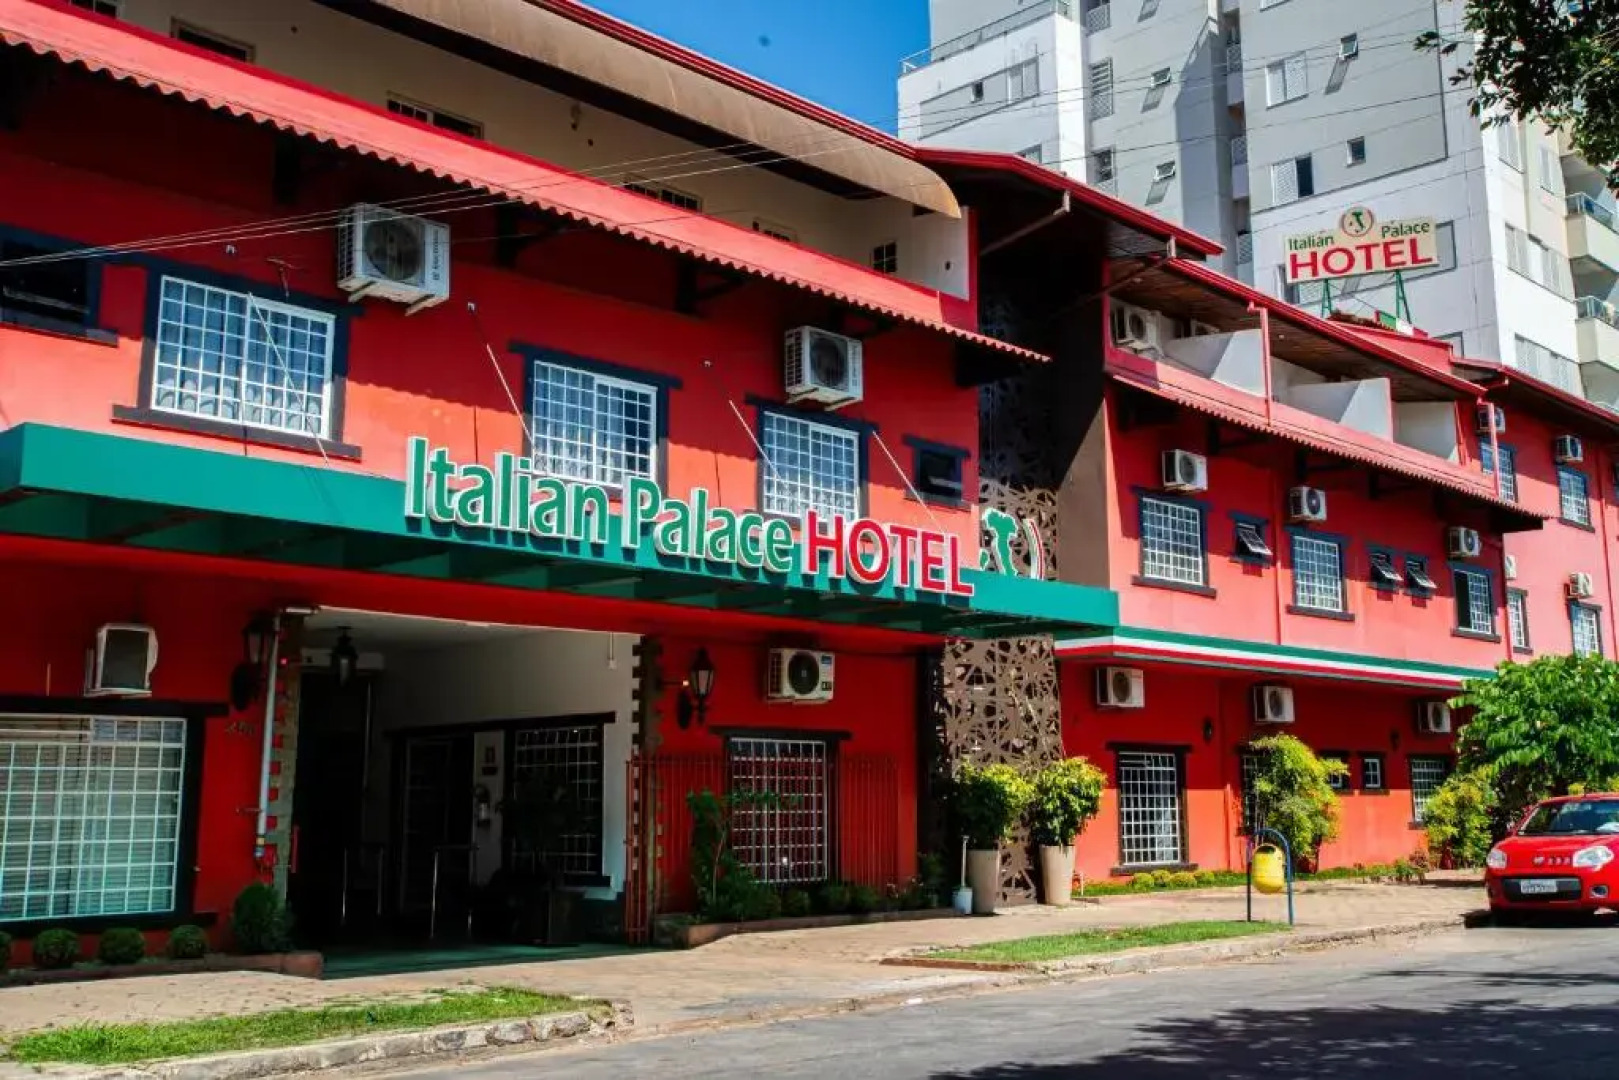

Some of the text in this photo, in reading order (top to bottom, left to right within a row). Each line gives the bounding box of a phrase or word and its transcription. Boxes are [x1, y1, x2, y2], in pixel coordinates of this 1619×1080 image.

[1289, 222, 1430, 250] Italian Palace
[1290, 238, 1432, 279] HOTEL
[406, 436, 974, 597] Italian Palace HOTEL
